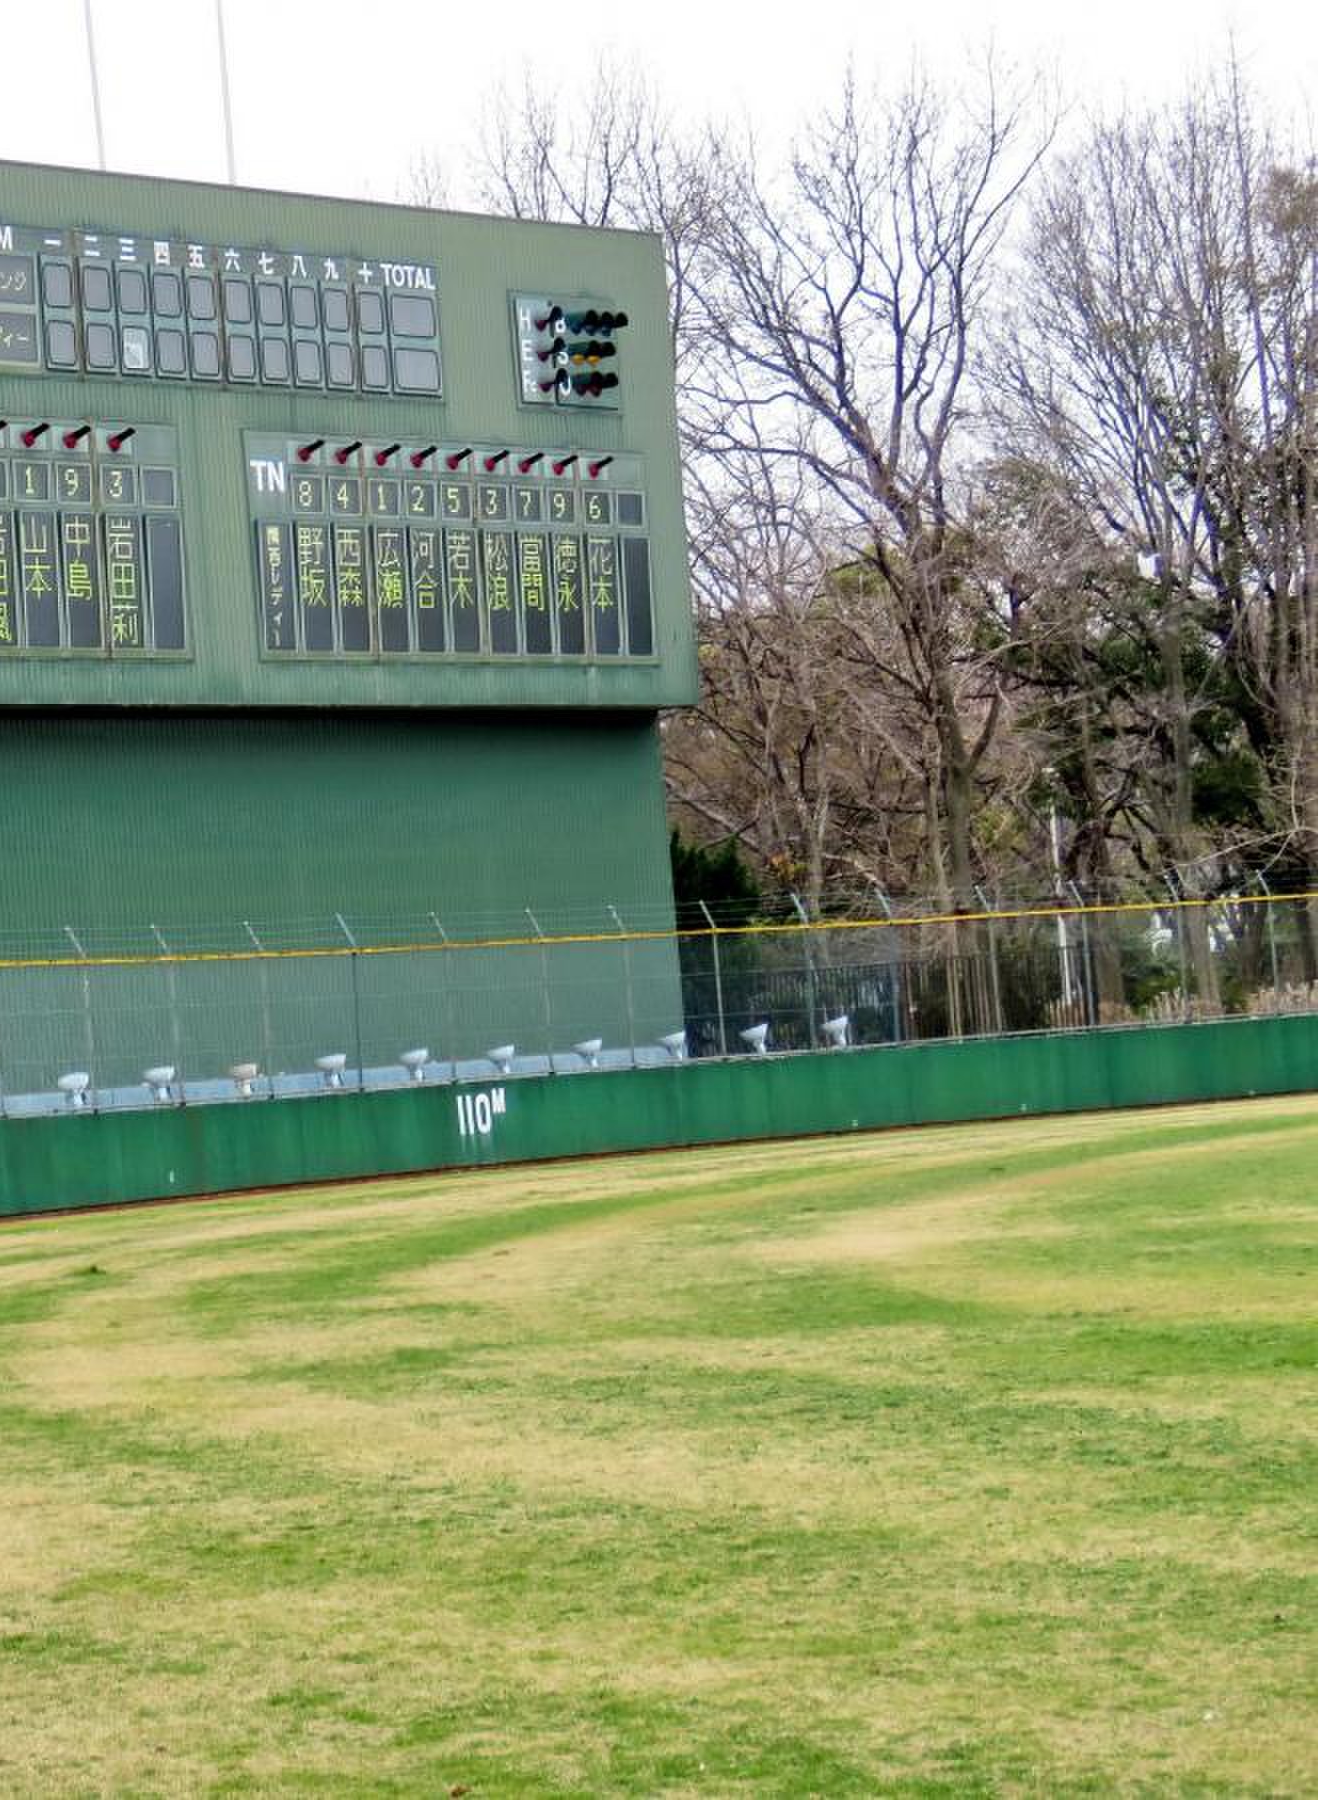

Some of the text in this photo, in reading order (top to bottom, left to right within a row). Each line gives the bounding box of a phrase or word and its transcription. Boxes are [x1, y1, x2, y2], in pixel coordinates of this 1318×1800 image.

[84, 235, 101, 257] 二
[119, 239, 136, 261] 三
[153, 241, 170, 266] 四
[187, 244, 205, 268] 五
[223, 248, 241, 271] 六
[258, 251, 275, 275] 七
[291, 255, 307, 277] 八
[323, 257, 340, 280] 九
[358, 263, 373, 284] 十
[380, 262, 436, 291] TOTAL
[522, 339, 534, 361] E
[25, 466, 34, 494] 1
[64, 468, 78, 496] 9
[109, 470, 122, 497] 3
[250, 459, 285, 492] TN
[298, 481, 601, 520] 8 4 1 2 5 3 7 9 6
[21, 514, 51, 599] 山本
[65, 515, 93, 601] 中島
[297, 527, 327, 607] 野坂
[411, 530, 439, 609] 河合
[447, 532, 473, 609] 若木
